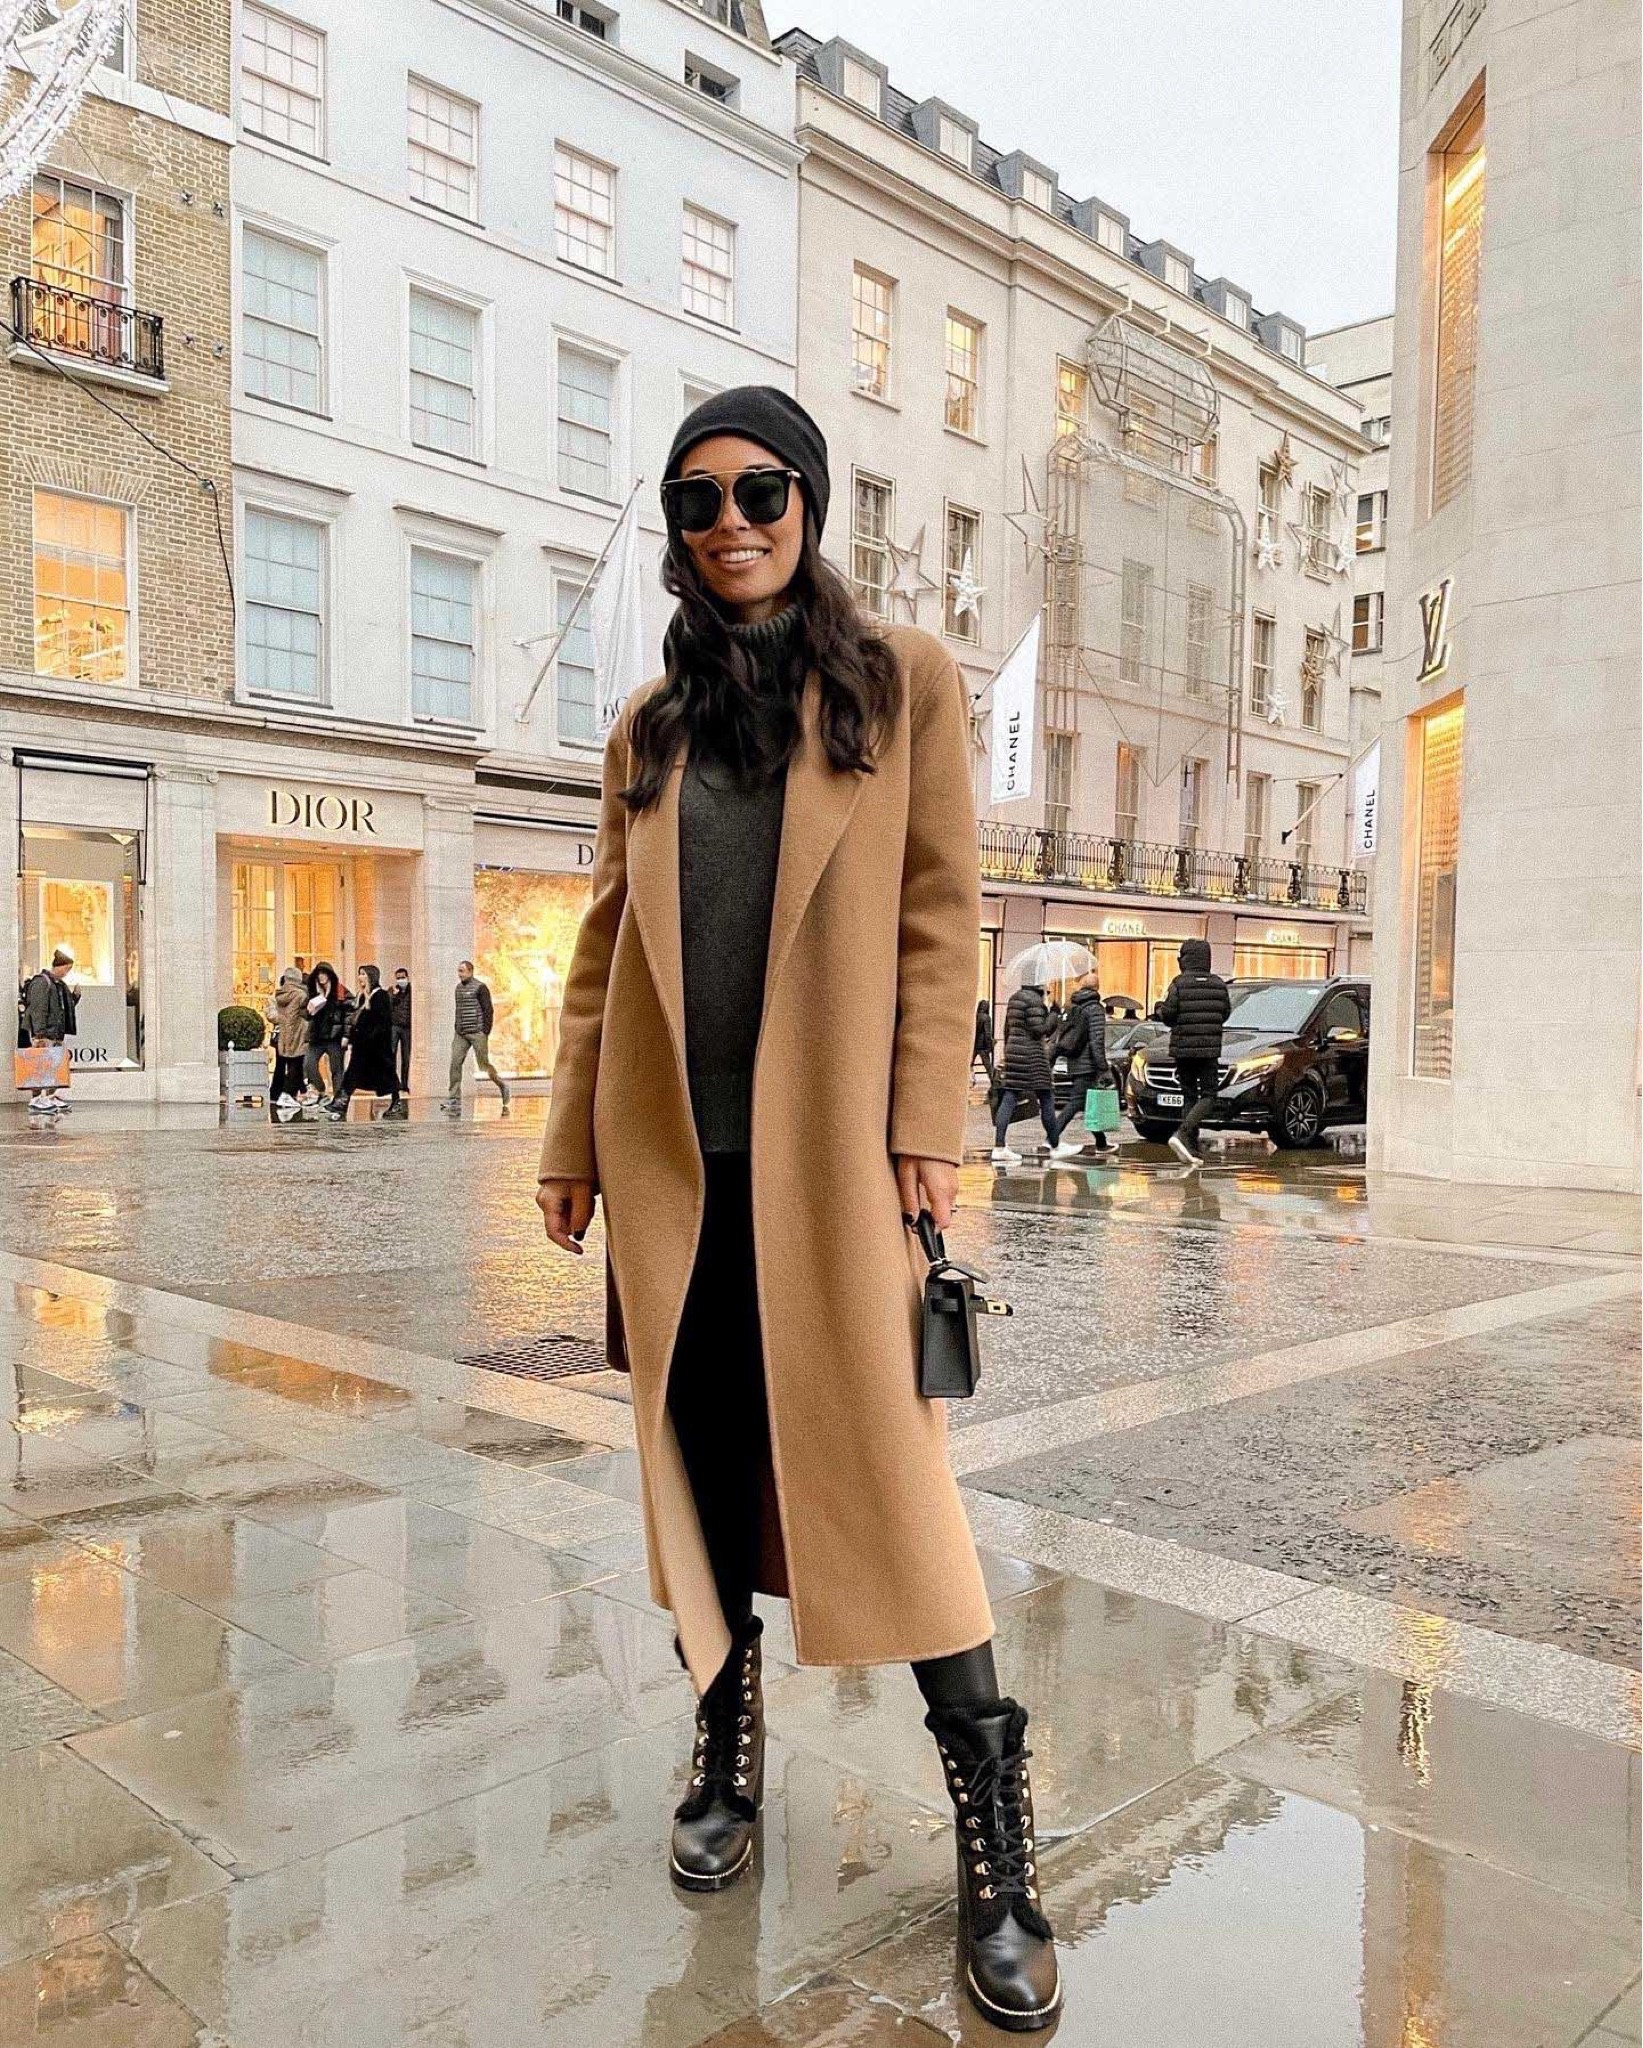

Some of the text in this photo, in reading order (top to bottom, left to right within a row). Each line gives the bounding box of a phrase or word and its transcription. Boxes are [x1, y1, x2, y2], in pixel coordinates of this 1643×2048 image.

[1007, 711, 1020, 791] CHANEL
[267, 790, 377, 834] DIOR
[1364, 789, 1375, 849] CHANEL
[1107, 921, 1147, 936] CHANEL
